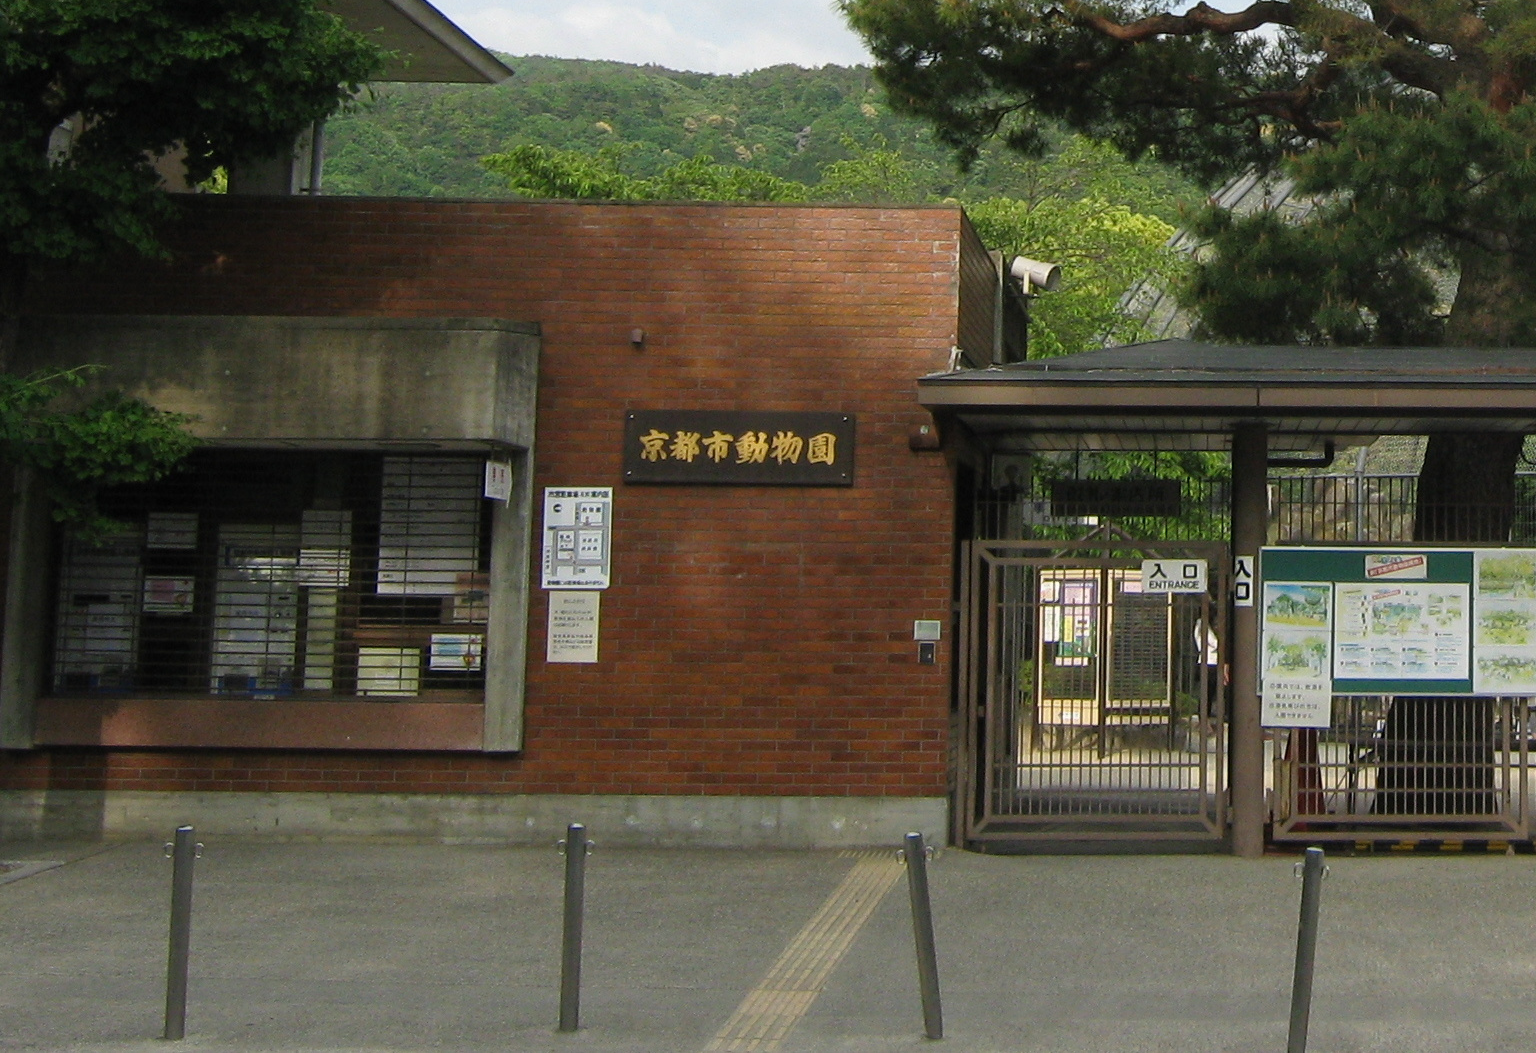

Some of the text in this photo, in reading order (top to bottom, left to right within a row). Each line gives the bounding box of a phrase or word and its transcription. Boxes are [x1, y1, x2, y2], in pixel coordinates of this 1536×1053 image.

[639, 429, 837, 465] 京都市動物園
[1149, 563, 1198, 579] 入口
[1236, 559, 1252, 600] 入口
[1148, 580, 1200, 589] ENTRANCE
